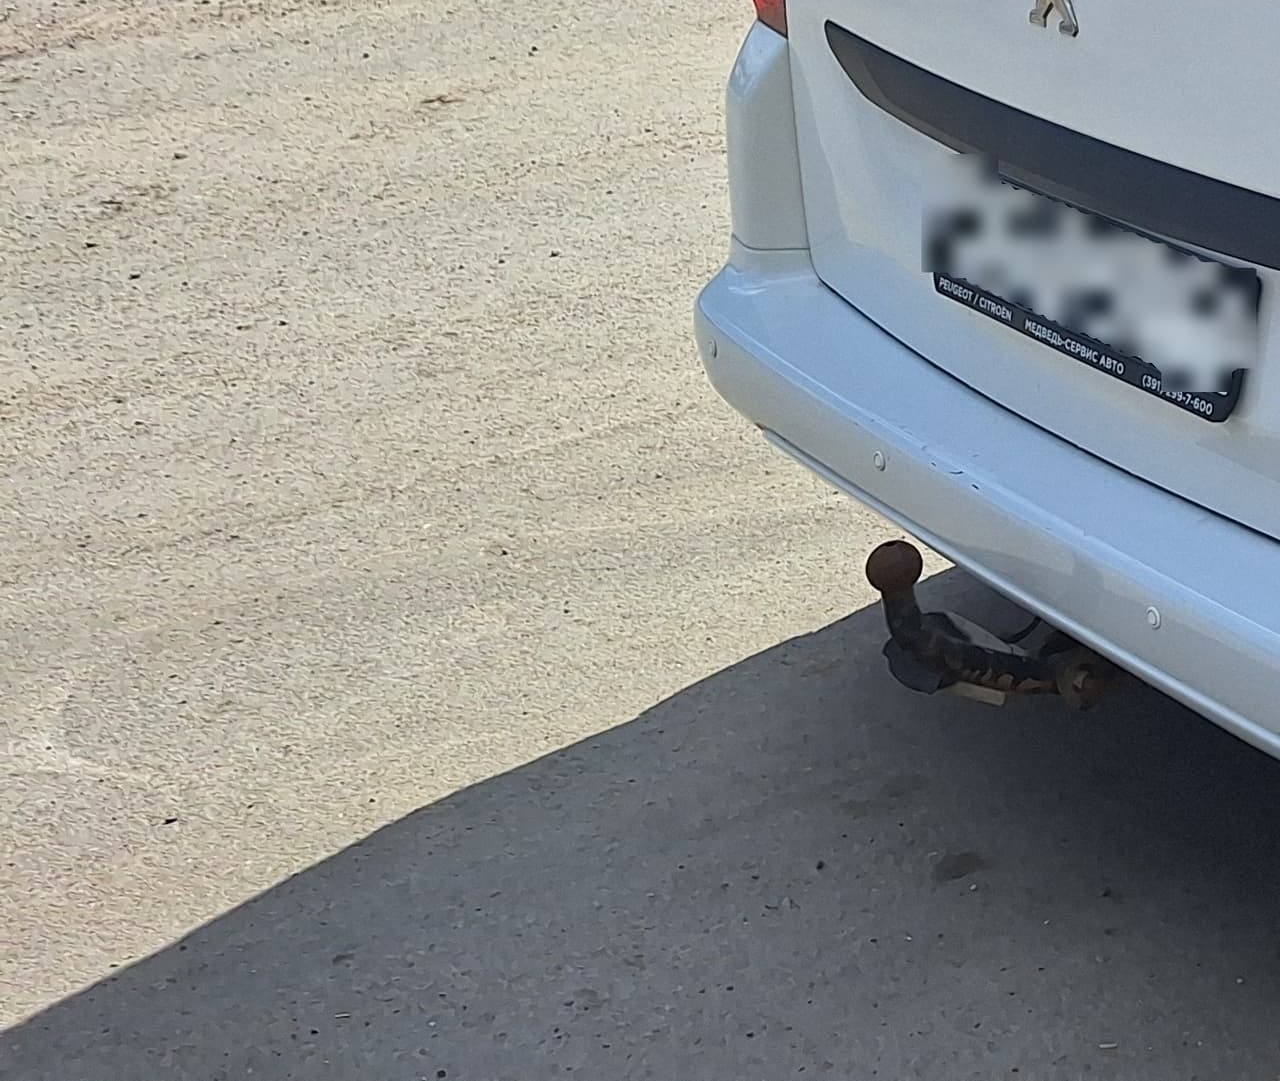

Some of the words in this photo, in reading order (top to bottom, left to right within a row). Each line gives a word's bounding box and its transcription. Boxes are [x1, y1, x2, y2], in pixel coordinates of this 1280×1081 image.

[938, 277, 974, 302] PEUGEOT
[1024, 319, 1099, 363] МЕДВЕДЬ-СЕРВИС
[1099, 355, 1125, 375] АВТО
[1142, 374, 1163, 395] (391
